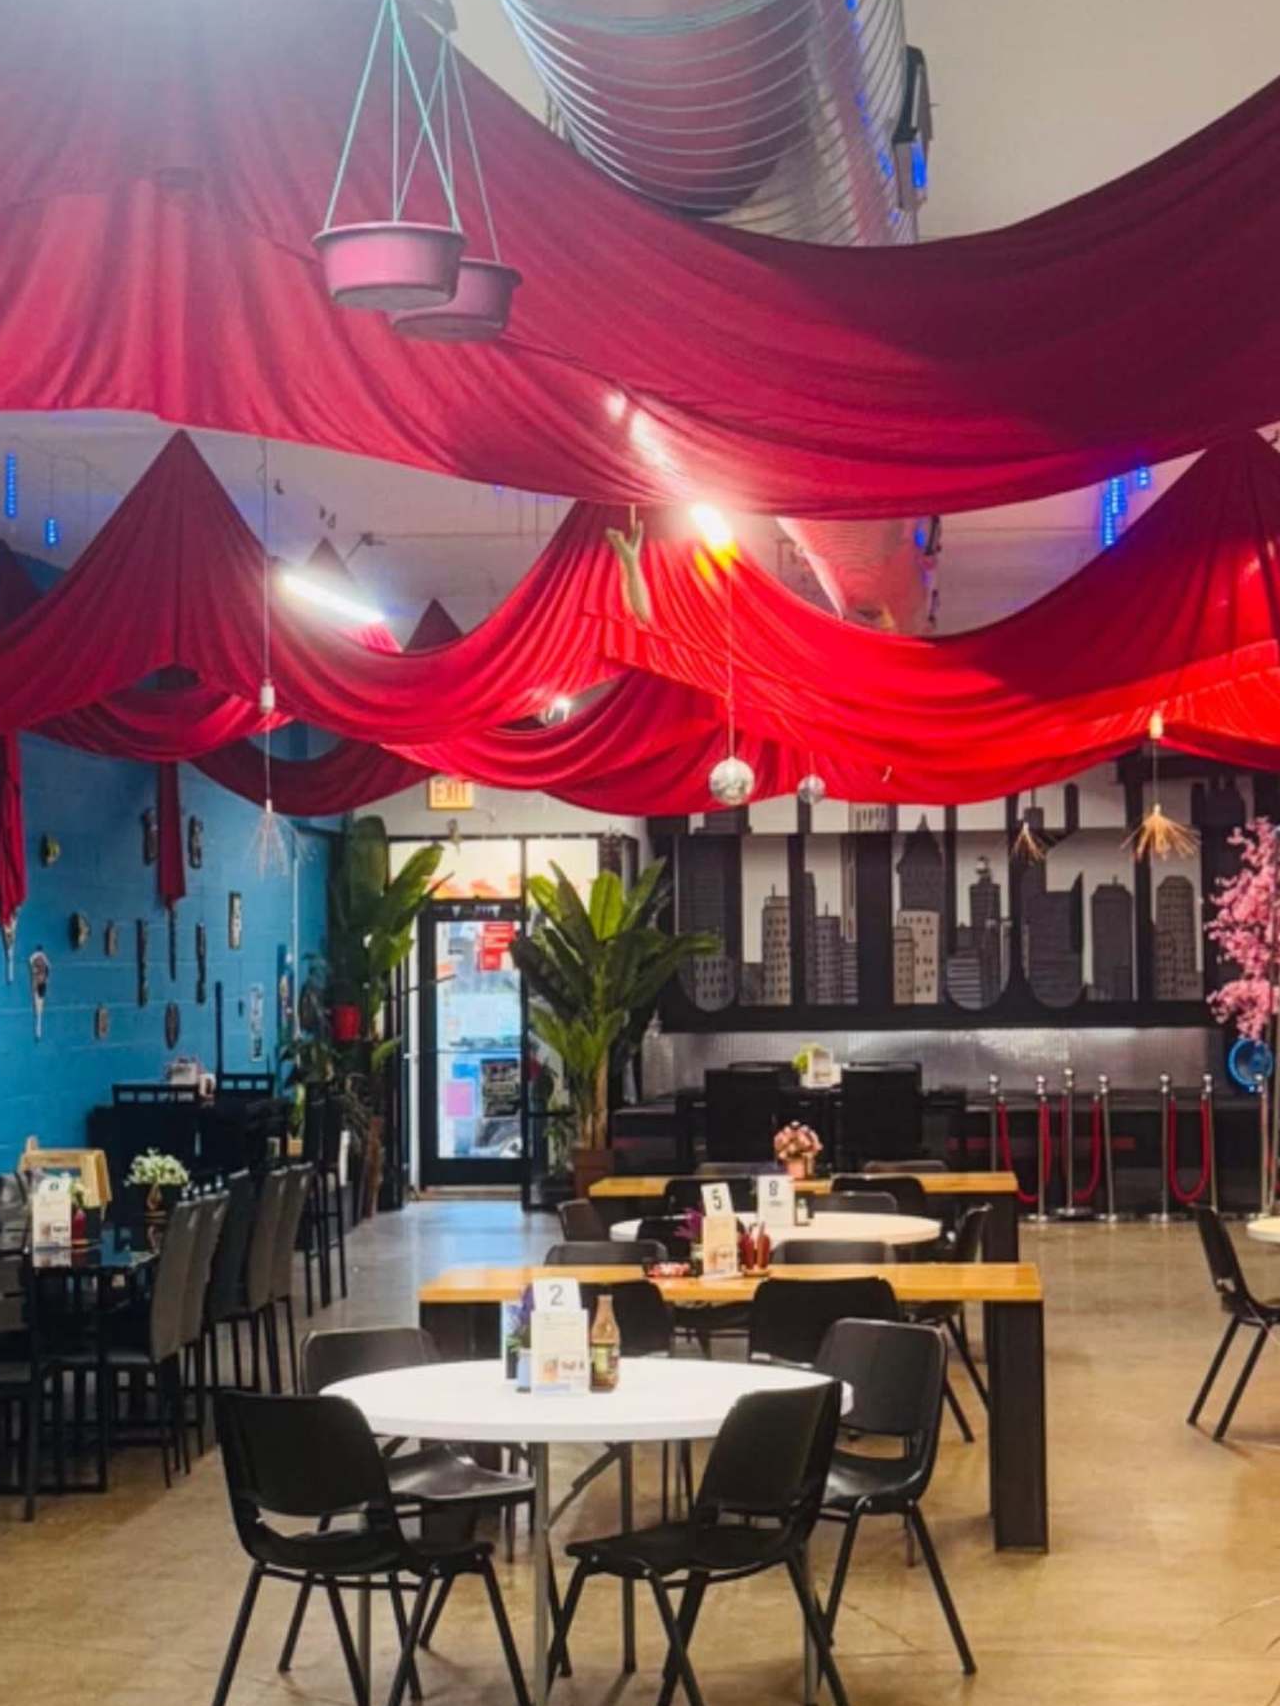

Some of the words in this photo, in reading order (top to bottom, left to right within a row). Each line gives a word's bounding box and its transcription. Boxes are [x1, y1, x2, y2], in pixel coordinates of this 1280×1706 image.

[435, 778, 467, 804] EXIT
[711, 1188, 723, 1210] 5
[549, 1284, 564, 1306] 2
